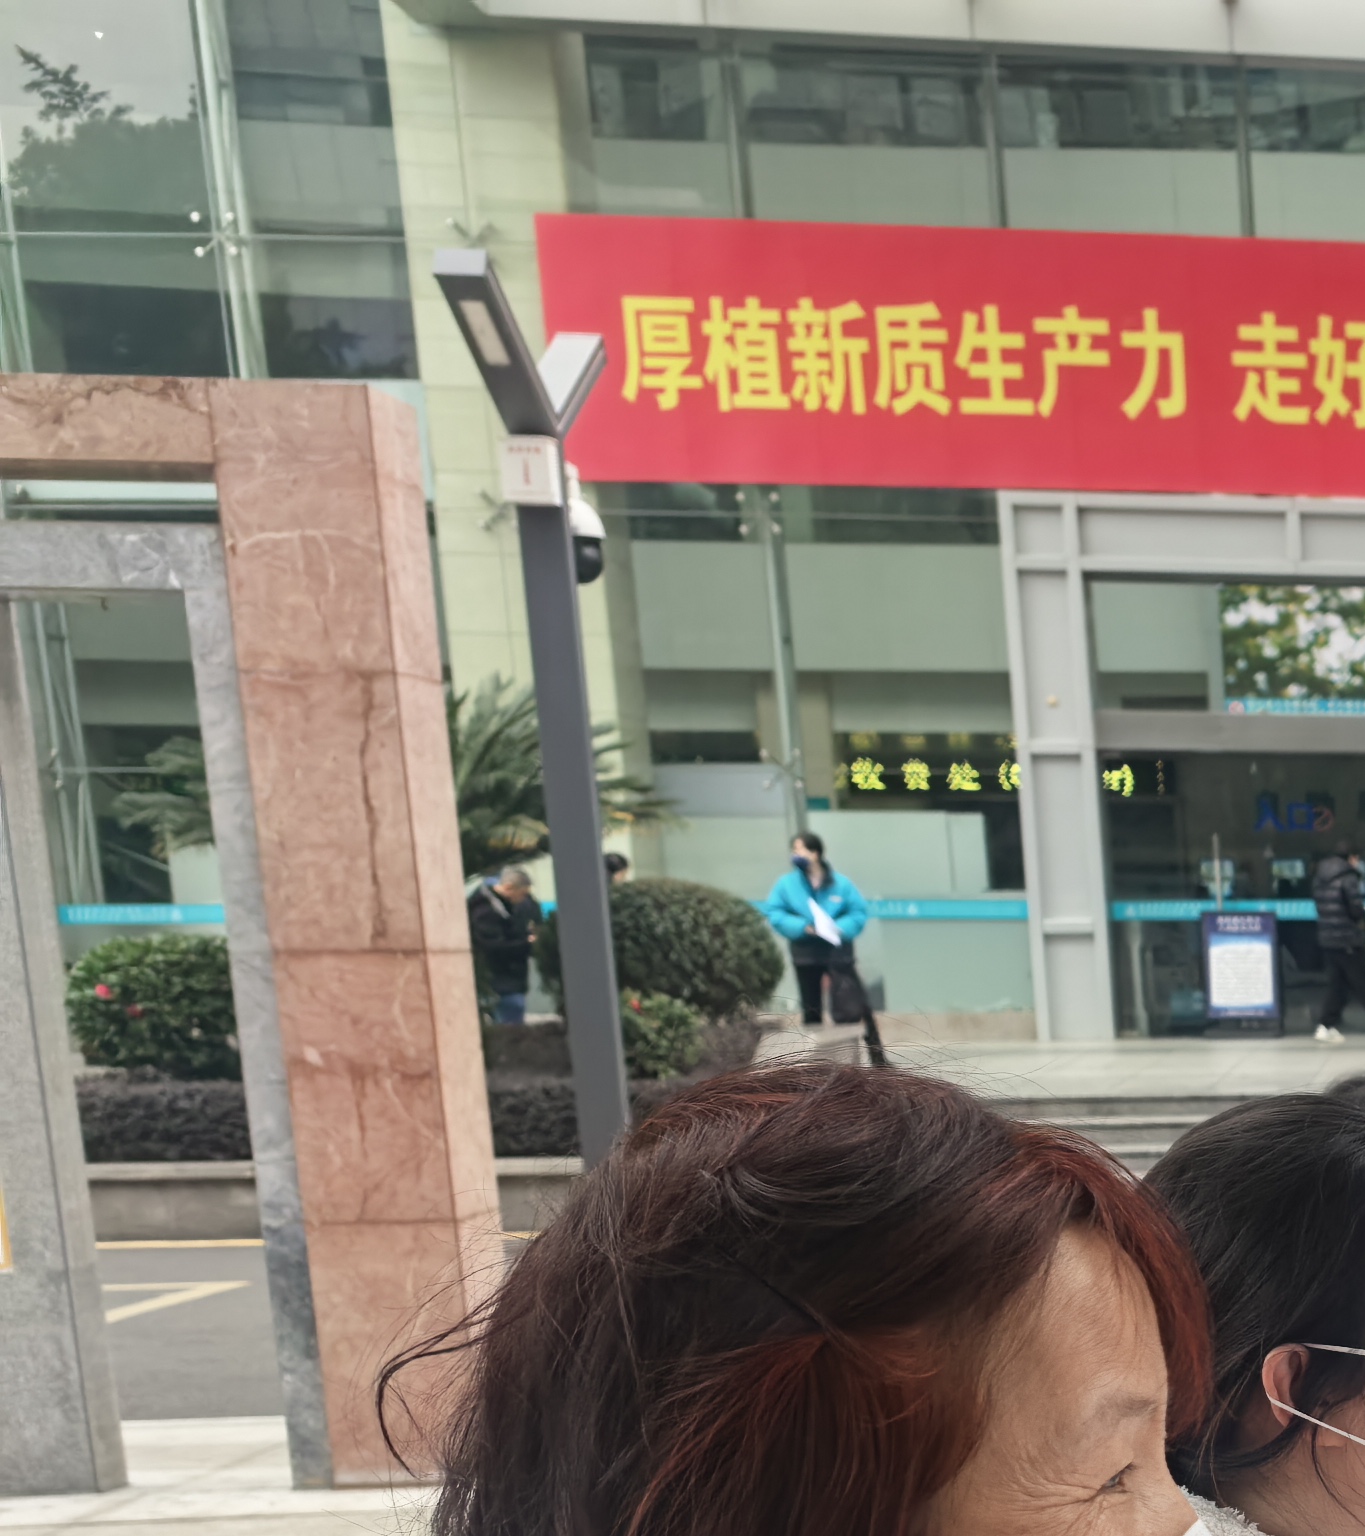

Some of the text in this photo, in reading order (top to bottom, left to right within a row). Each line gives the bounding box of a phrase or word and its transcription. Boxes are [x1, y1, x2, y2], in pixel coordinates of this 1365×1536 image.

[620, 294, 1188, 421] 厚植新质生产力
